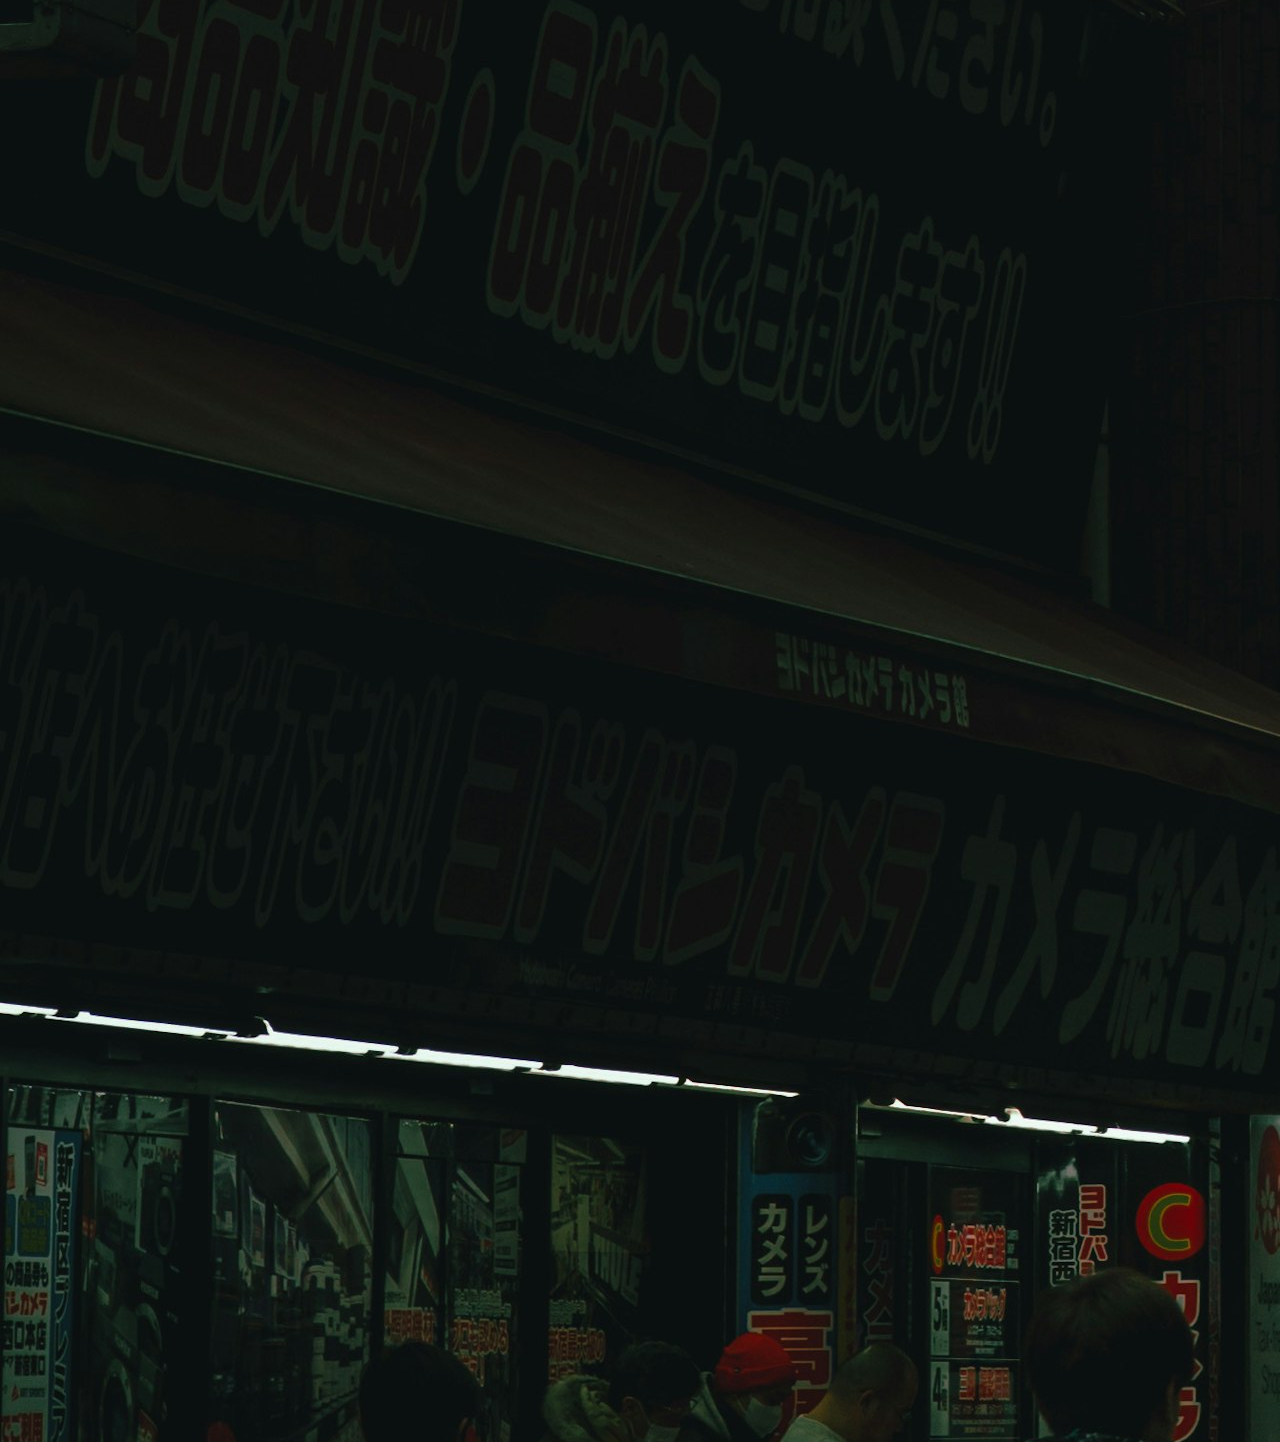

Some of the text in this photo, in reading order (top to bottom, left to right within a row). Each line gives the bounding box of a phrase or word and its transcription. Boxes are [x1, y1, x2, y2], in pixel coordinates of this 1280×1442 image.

[775, 631, 893, 714] ヨドバシカメラ
[434, 690, 946, 1002] ヨドバシカメラ
[756, 1203, 788, 1299] カメラ
[803, 1203, 830, 1296] レンズ
[946, 1222, 1007, 1270] カメラ総合館
